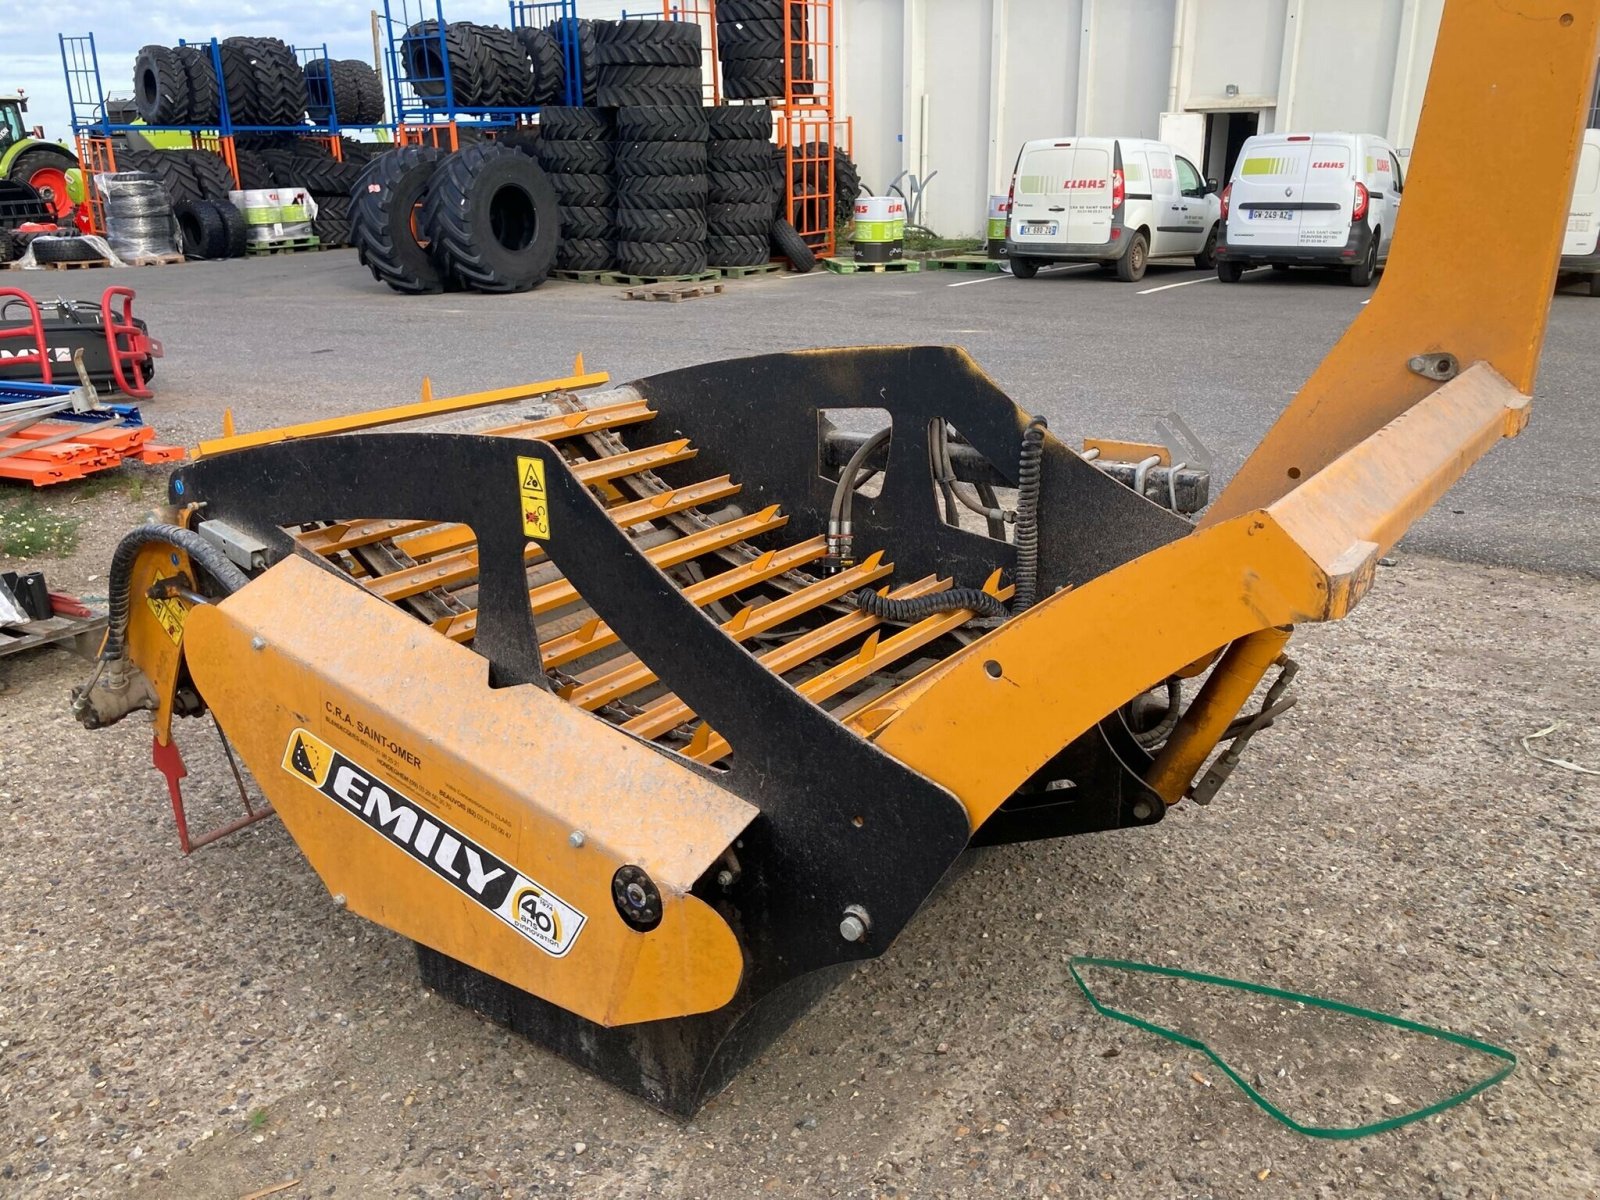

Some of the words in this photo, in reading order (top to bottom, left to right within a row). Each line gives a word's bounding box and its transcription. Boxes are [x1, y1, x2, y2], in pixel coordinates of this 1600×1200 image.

[1063, 180, 1107, 189] CLAAS
[326, 701, 355, 727] C.R.A.
[357, 721, 421, 769] SAINT-OMER
[438, 788, 466, 811] BEAUVOIS
[333, 766, 507, 896] EMILY
[520, 914, 538, 931] ans
[522, 899, 551, 932] 40
